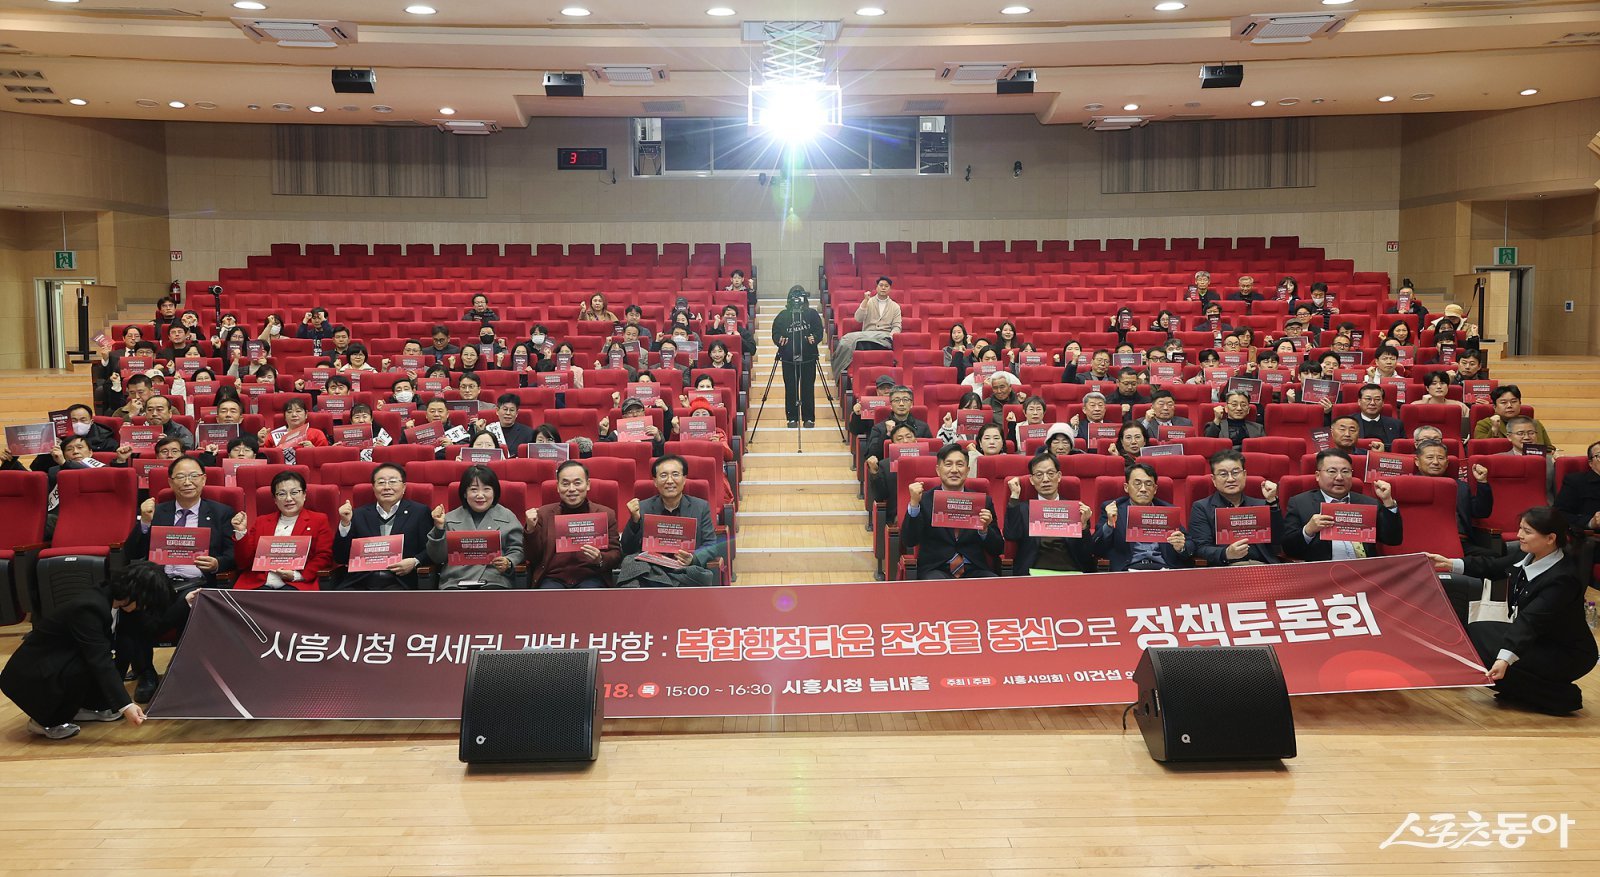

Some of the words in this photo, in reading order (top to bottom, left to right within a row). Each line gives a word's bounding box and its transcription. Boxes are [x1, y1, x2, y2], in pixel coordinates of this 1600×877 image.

[260, 631, 396, 665] 시흥시청
[588, 631, 654, 663] 방향
[676, 623, 875, 663] 복합행정타운
[881, 619, 982, 656] 조성을
[986, 616, 1121, 653] 중심으로
[1125, 591, 1382, 650] 정책토론회
[603, 682, 634, 699] 18.
[641, 684, 656, 696] 목
[665, 685, 710, 697] 15:00
[728, 683, 773, 696] 16:30
[781, 678, 863, 695] 시흥시청
[869, 675, 930, 692] 늠내홀
[1002, 673, 1064, 686] 시흥시의회
[1073, 669, 1123, 682] 이건섭
